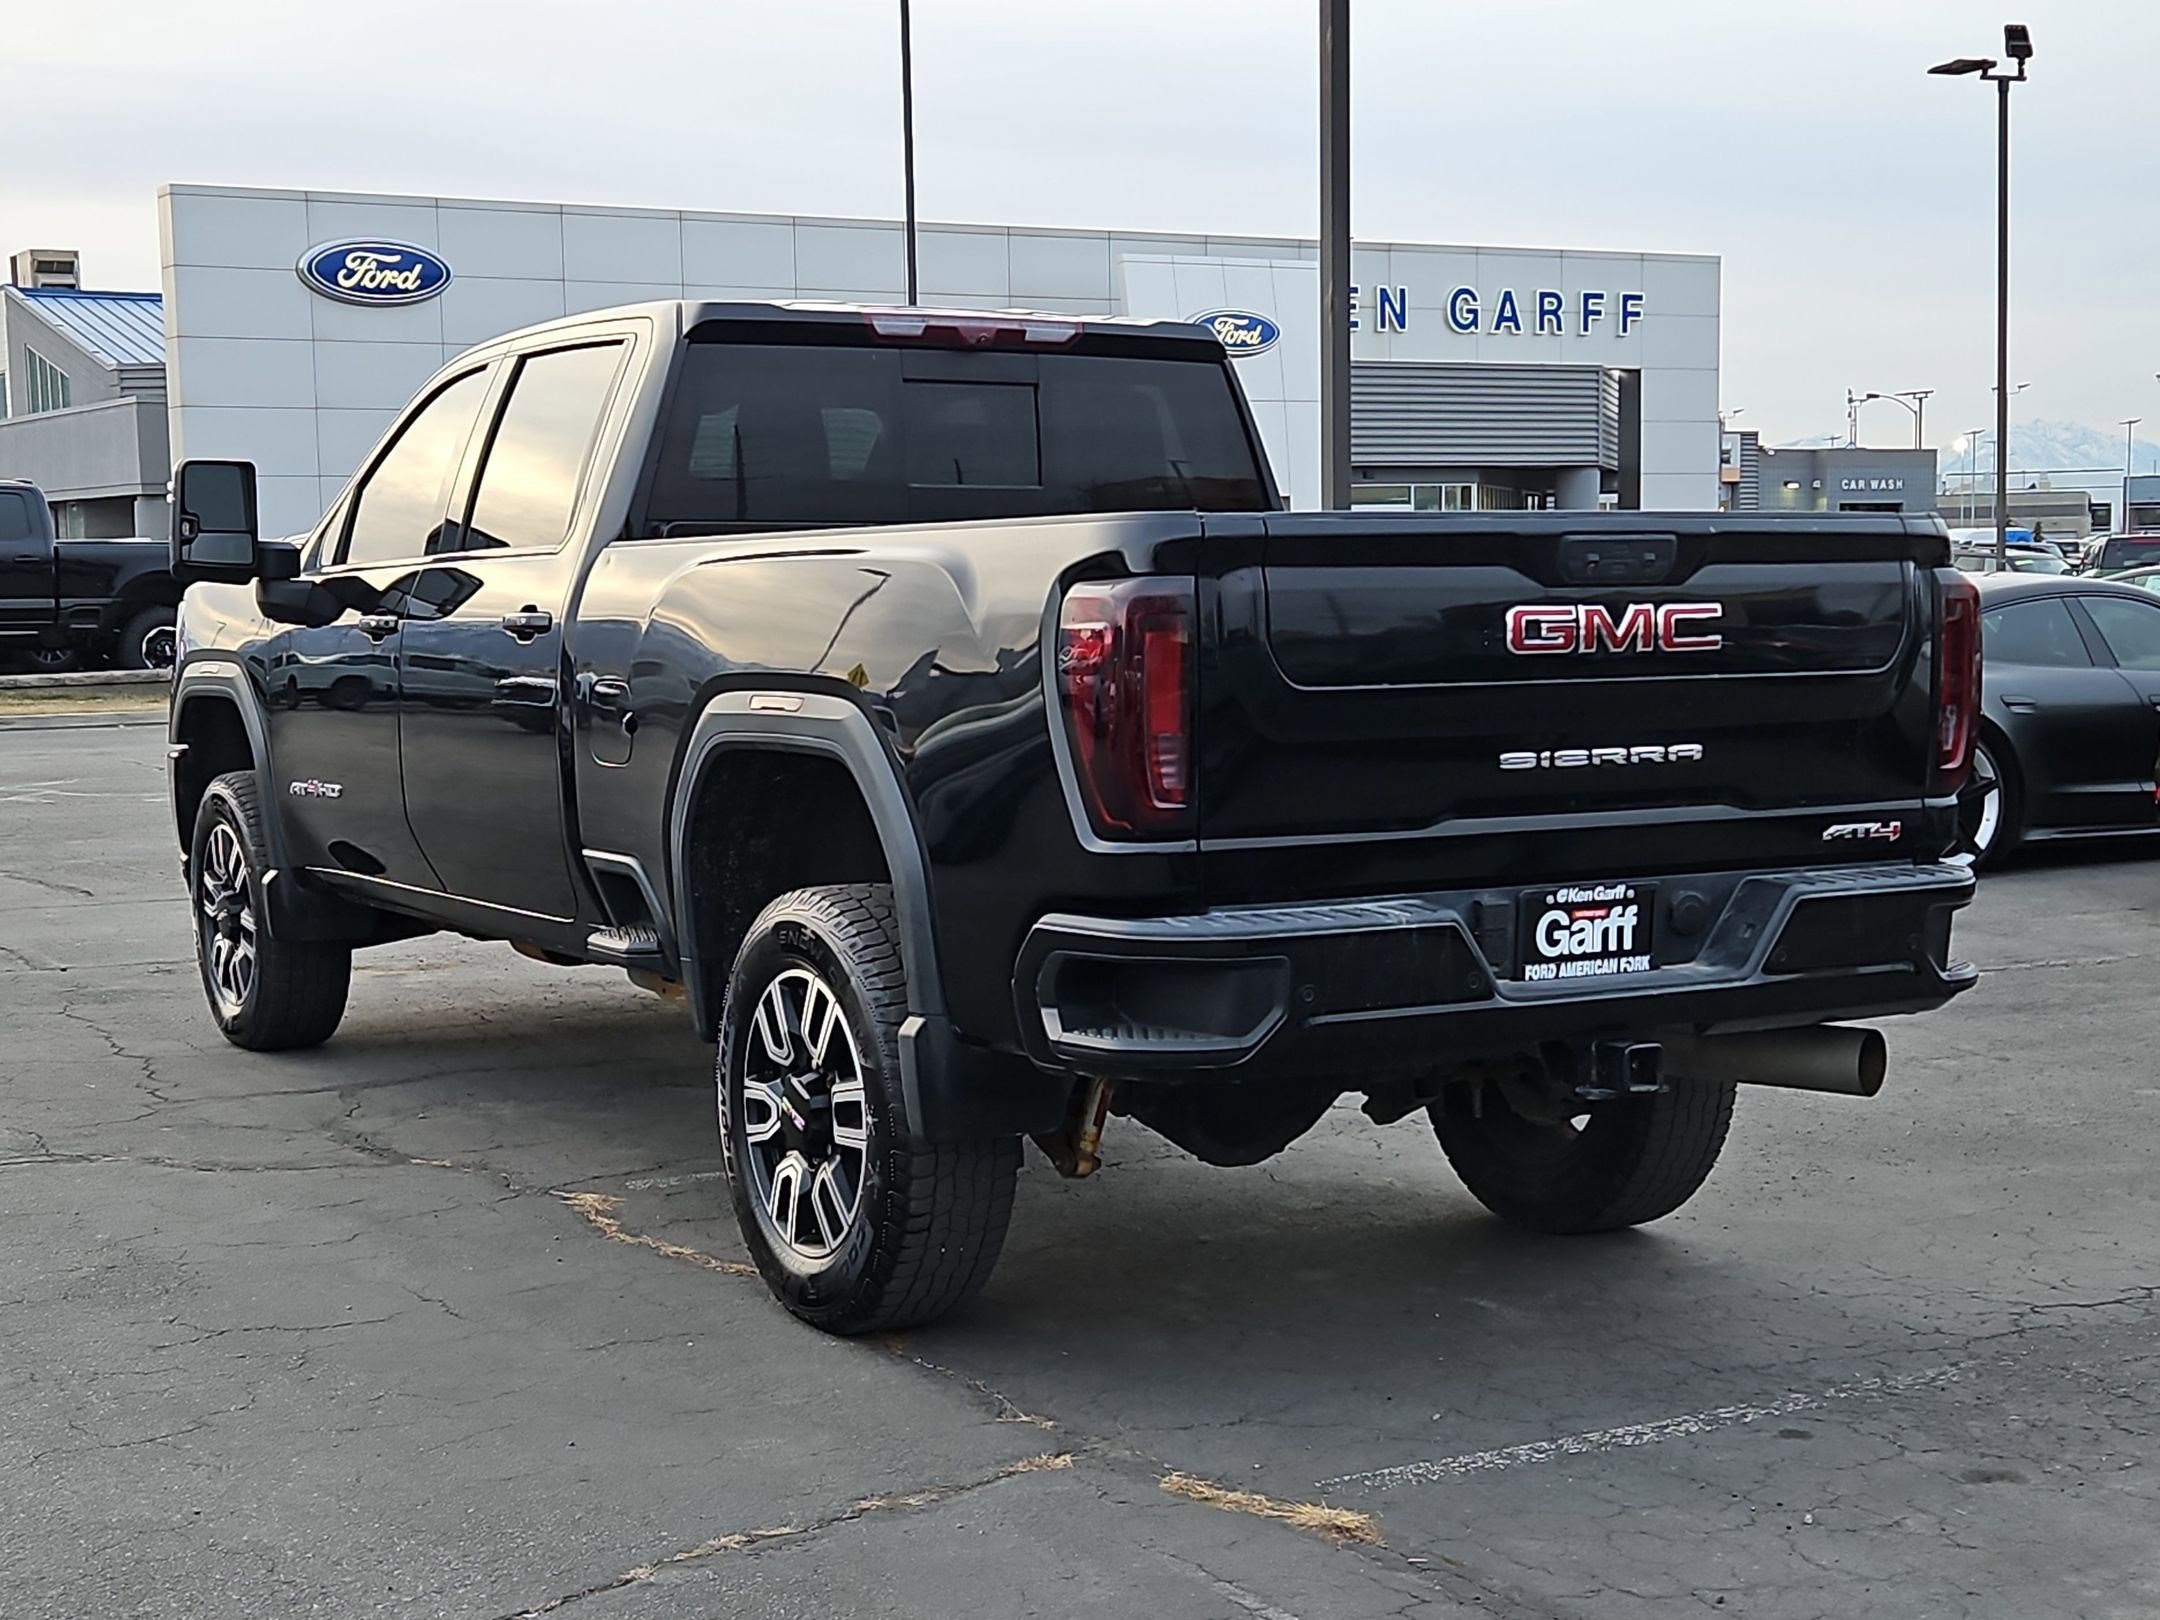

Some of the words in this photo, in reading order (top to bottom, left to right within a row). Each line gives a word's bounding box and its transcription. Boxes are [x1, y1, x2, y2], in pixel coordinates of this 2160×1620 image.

[337, 251, 424, 290] Ford
[1447, 285, 1646, 337] GARFF
[1213, 316, 1263, 345] Ford
[1841, 479, 1865, 490] CAR
[1870, 479, 1903, 490] WASH
[1505, 602, 1722, 655] GMC
[1499, 743, 1703, 770] SIERRA
[1822, 821, 1901, 842] AT4
[1535, 904, 1638, 957] Garff
[1525, 963, 1557, 981] FORD
[1559, 957, 1618, 978] AMERICAN
[1620, 954, 1651, 973] FORK
